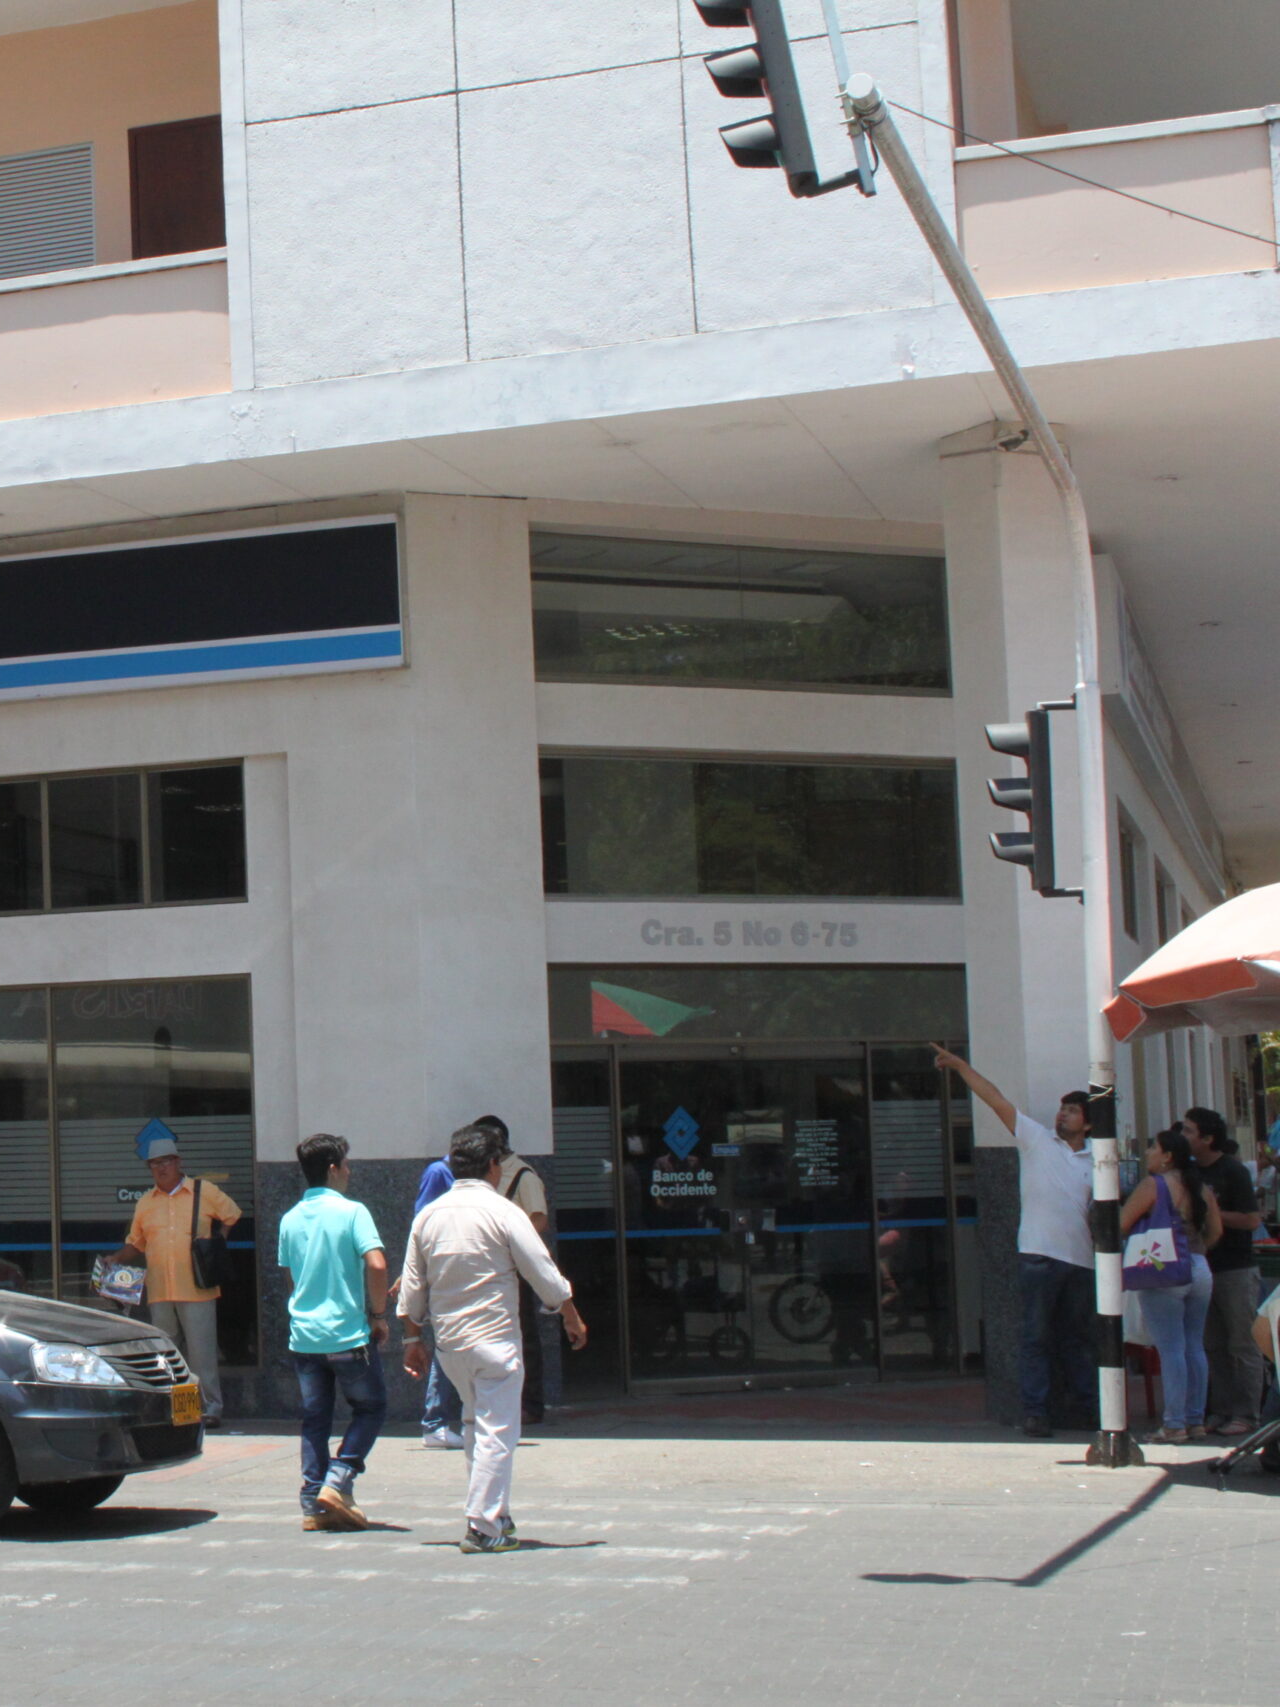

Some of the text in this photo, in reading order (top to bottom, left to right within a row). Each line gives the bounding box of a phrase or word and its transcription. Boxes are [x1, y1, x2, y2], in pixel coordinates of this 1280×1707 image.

[640, 918, 859, 947] Cra. 5 No 6-75
[652, 1169, 714, 1182] Banco de
[650, 1183, 718, 1197] Occidente
